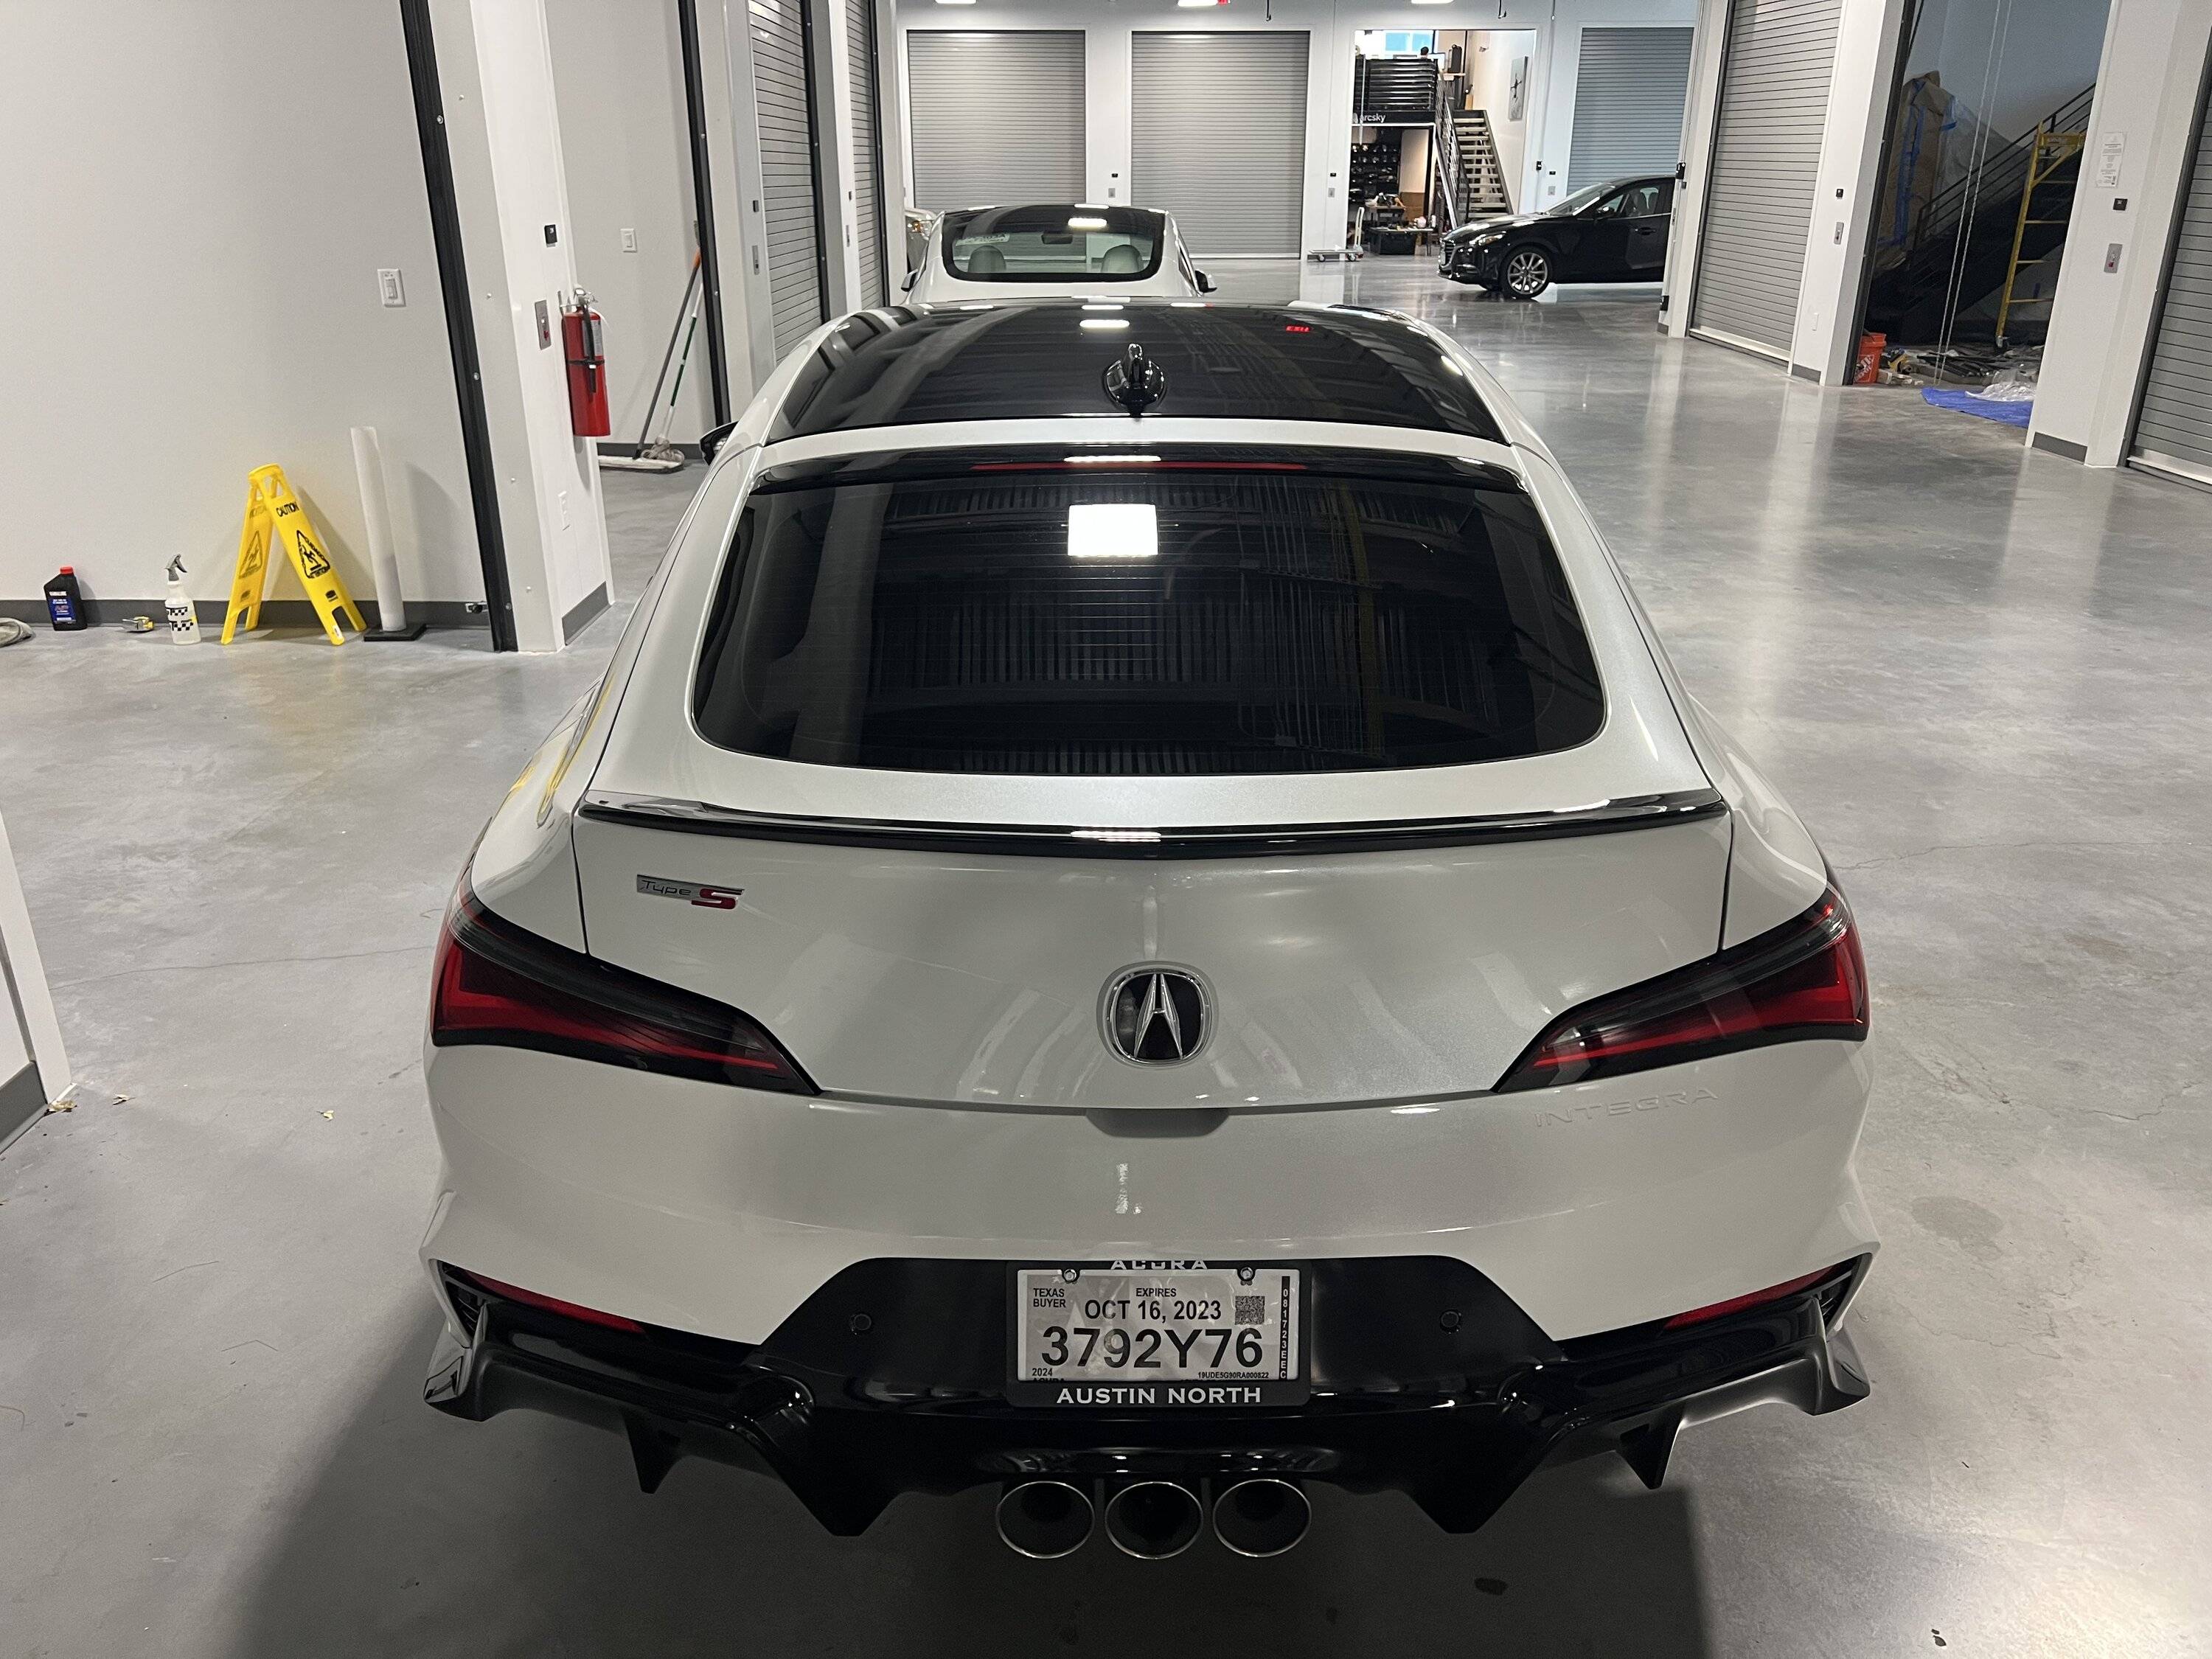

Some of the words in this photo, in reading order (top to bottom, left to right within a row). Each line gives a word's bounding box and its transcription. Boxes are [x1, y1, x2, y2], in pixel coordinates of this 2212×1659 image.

[276, 501, 299, 517] CAUTION
[641, 879, 692, 896] Type
[691, 888, 742, 910] S
[1534, 1087, 1719, 1127] INTEGRA
[1110, 1260, 1208, 1270] ACURA
[1033, 1287, 1065, 1298] TEXAS
[1135, 1287, 1177, 1298] EXPIRES
[1033, 1298, 1066, 1308] BUYER
[1084, 1300, 1130, 1320] OCT
[1138, 1300, 1166, 1324] 16,
[1174, 1300, 1222, 1321] 2023
[1041, 1326, 1263, 1368] 3792Y76
[1032, 1368, 1053, 1377] 2024
[1057, 1388, 1155, 1405] AUSTIN
[1168, 1387, 1262, 1404] NORTH
